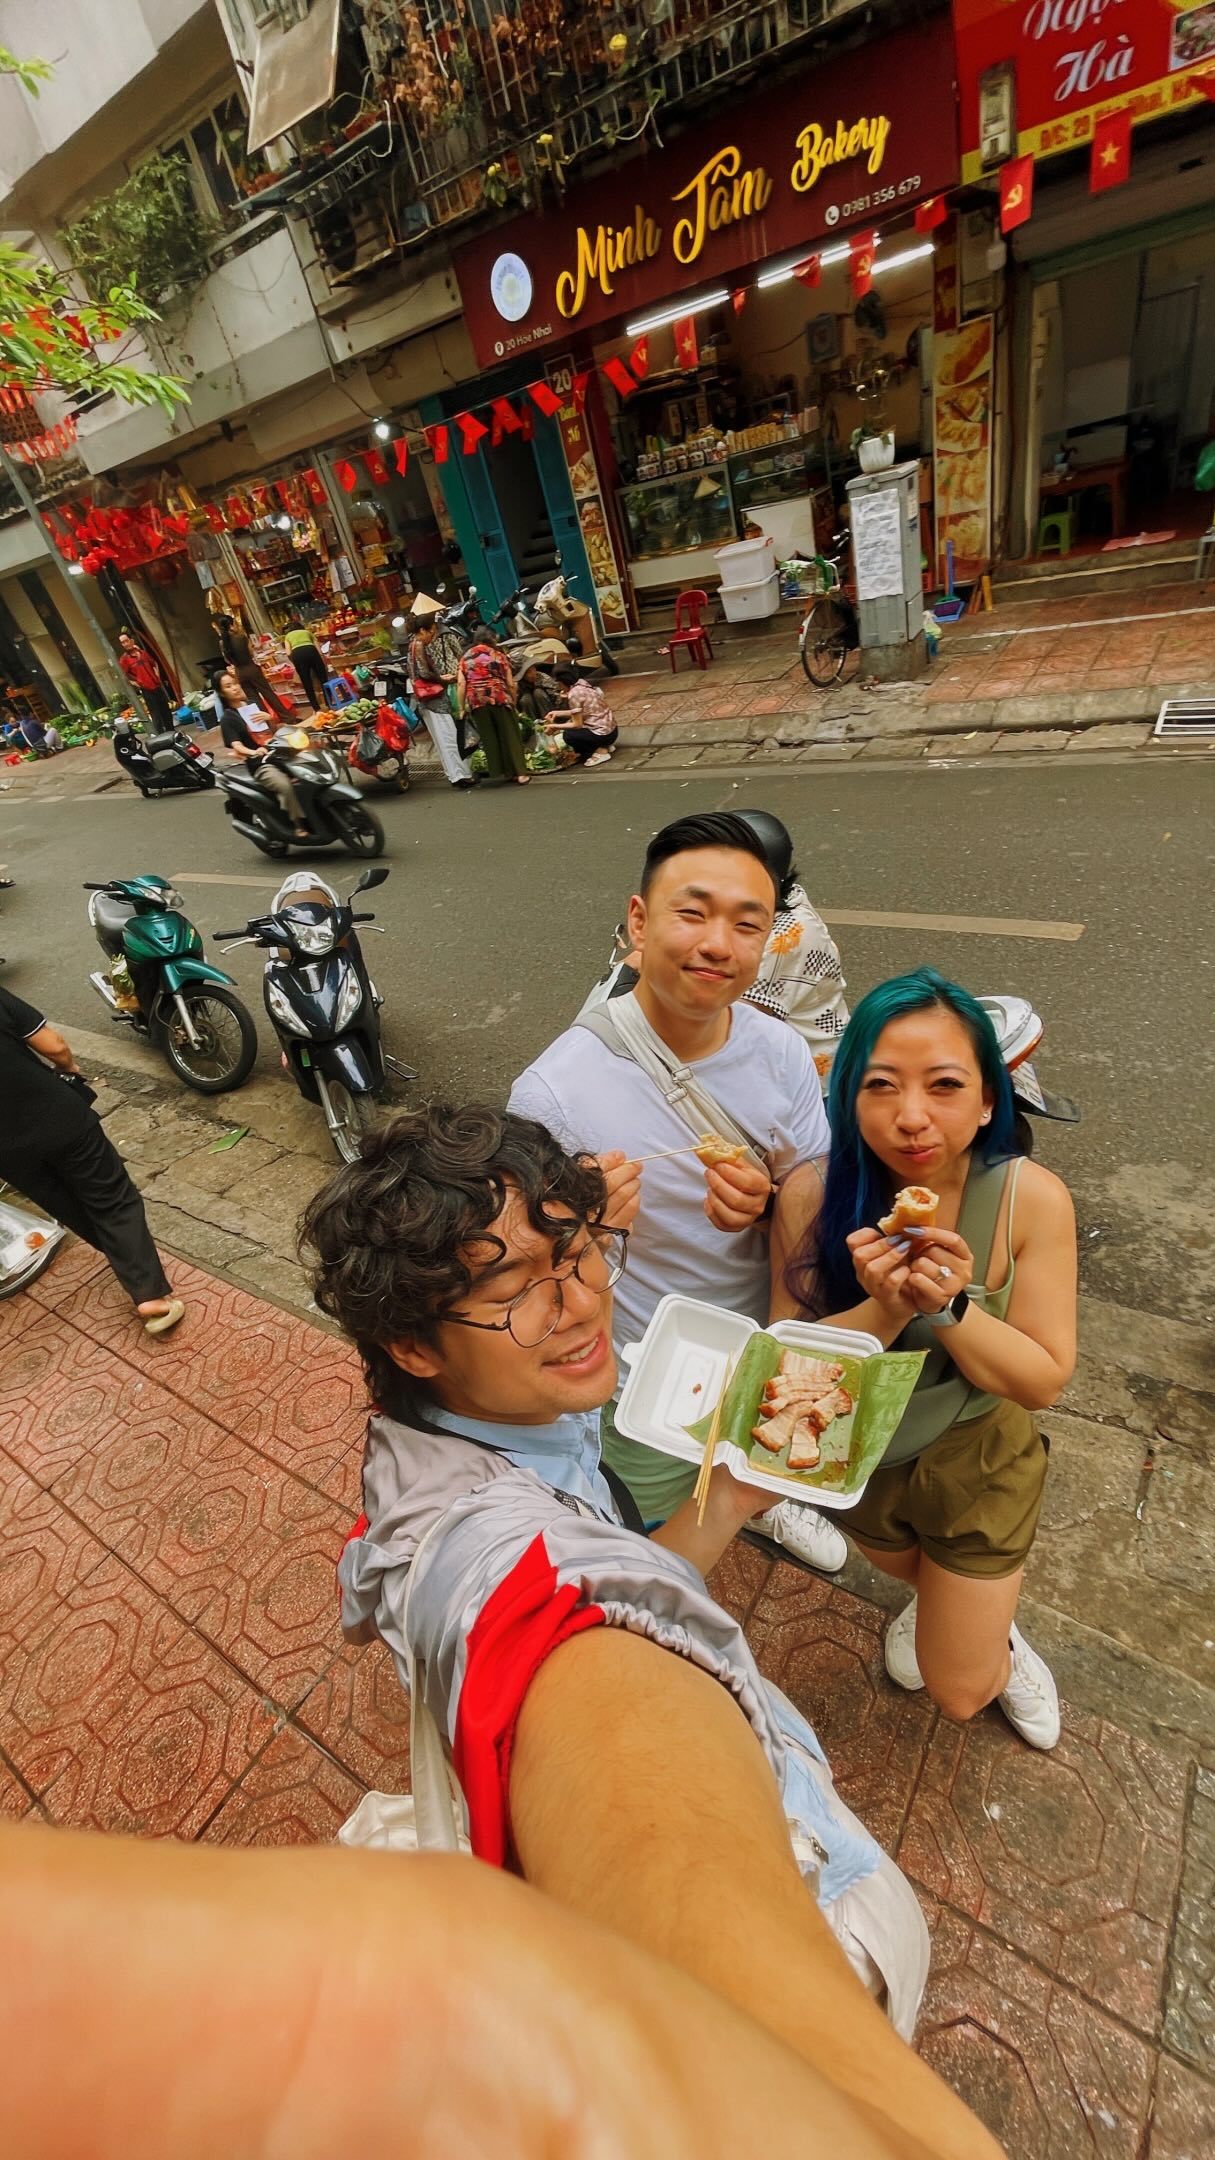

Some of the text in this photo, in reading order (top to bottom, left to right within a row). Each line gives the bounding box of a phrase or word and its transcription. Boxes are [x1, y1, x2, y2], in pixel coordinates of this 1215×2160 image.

[1053, 34, 1136, 102] Hà
[555, 114, 890, 319] Minh Tâm Bakery
[842, 175, 921, 217] 0981 356 679
[553, 368, 572, 393] 20
